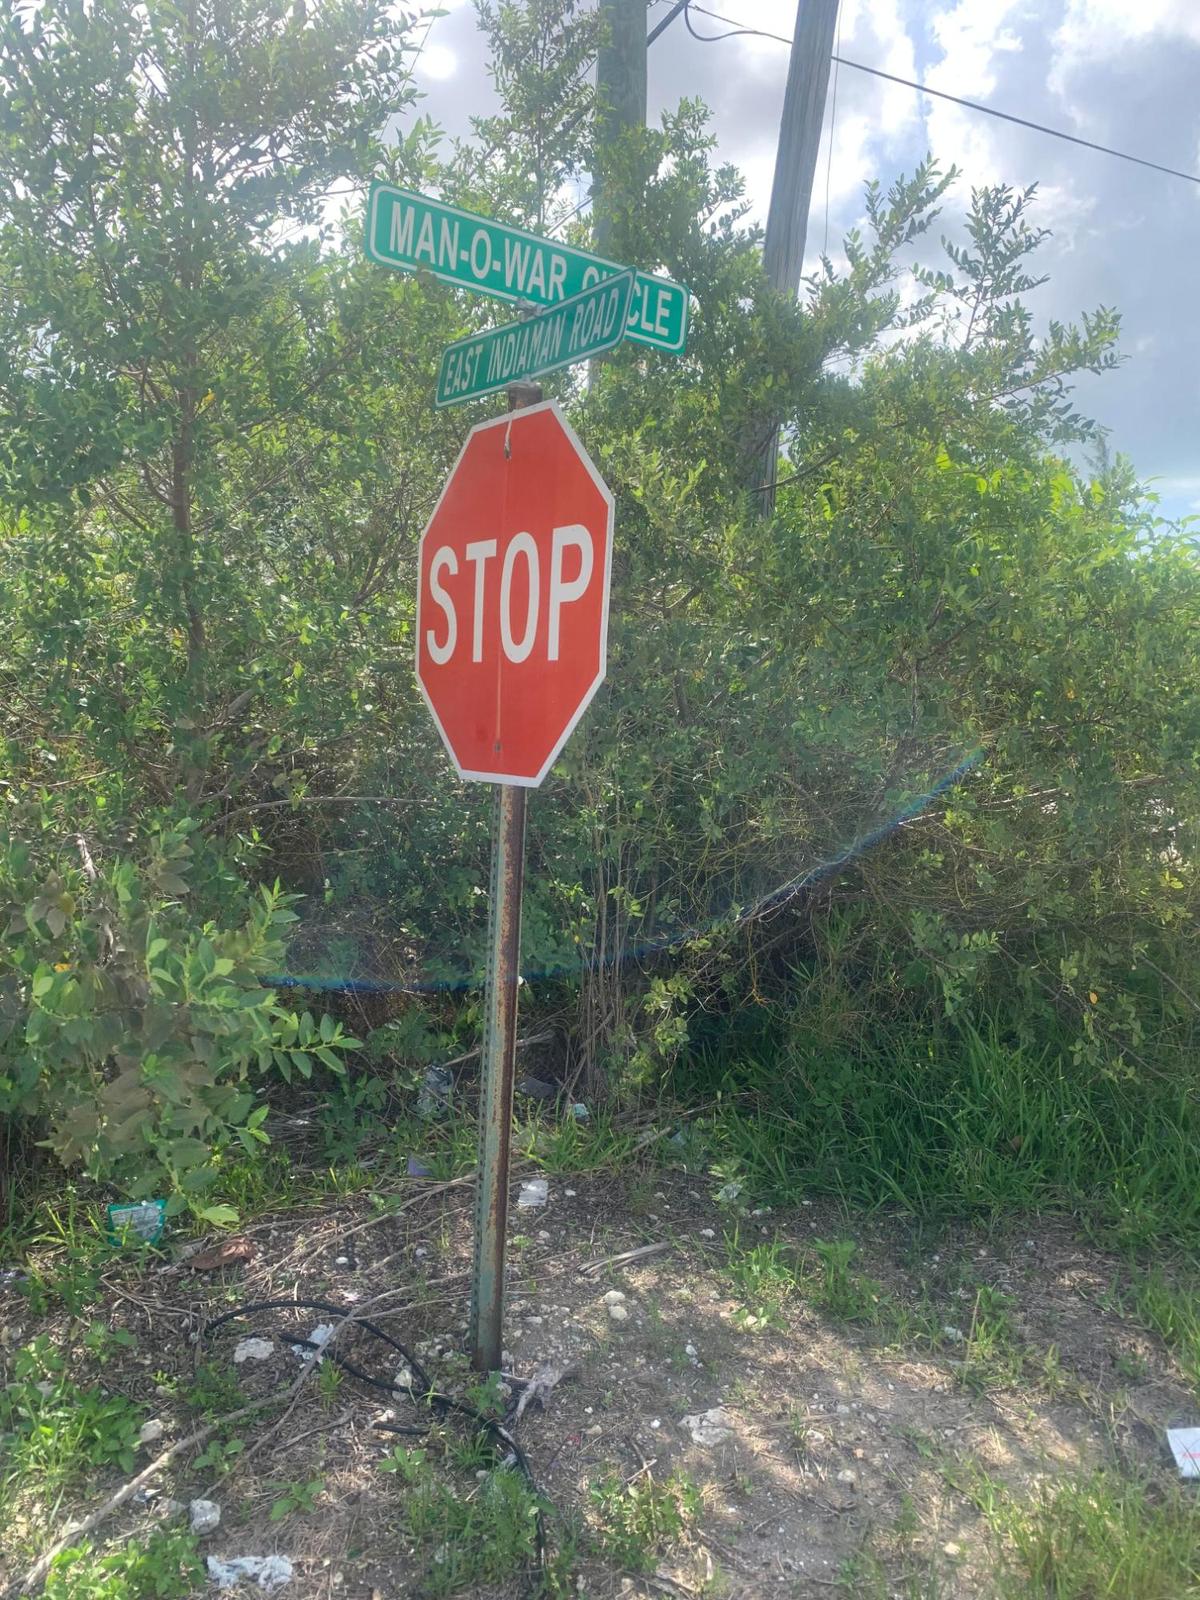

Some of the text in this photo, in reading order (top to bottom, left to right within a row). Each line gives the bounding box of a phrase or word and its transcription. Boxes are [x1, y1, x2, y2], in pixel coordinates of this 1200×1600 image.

[389, 201, 672, 336] MAN-O-WAR CLE
[444, 288, 619, 396] EAST INDIAMAN ROAD
[426, 524, 594, 665] STOP
